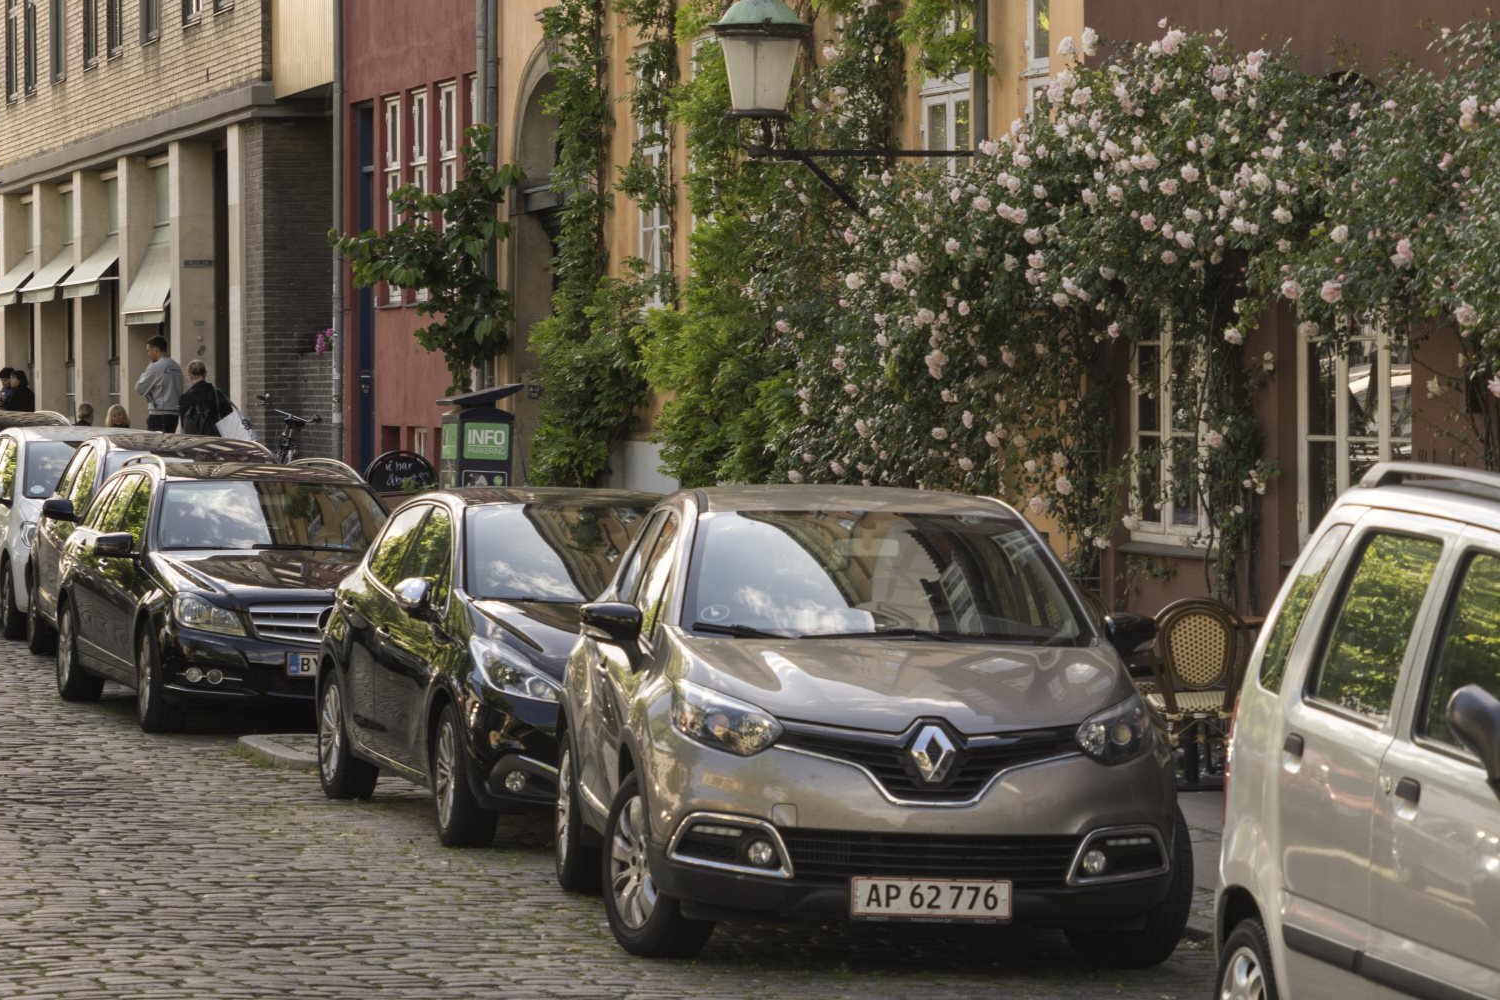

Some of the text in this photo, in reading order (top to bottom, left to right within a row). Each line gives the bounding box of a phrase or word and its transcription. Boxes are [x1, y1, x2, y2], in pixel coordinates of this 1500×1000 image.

[467, 429, 505, 445] INFO
[467, 446, 505, 456] PARKERING
[866, 884, 998, 911] AP 62 776
